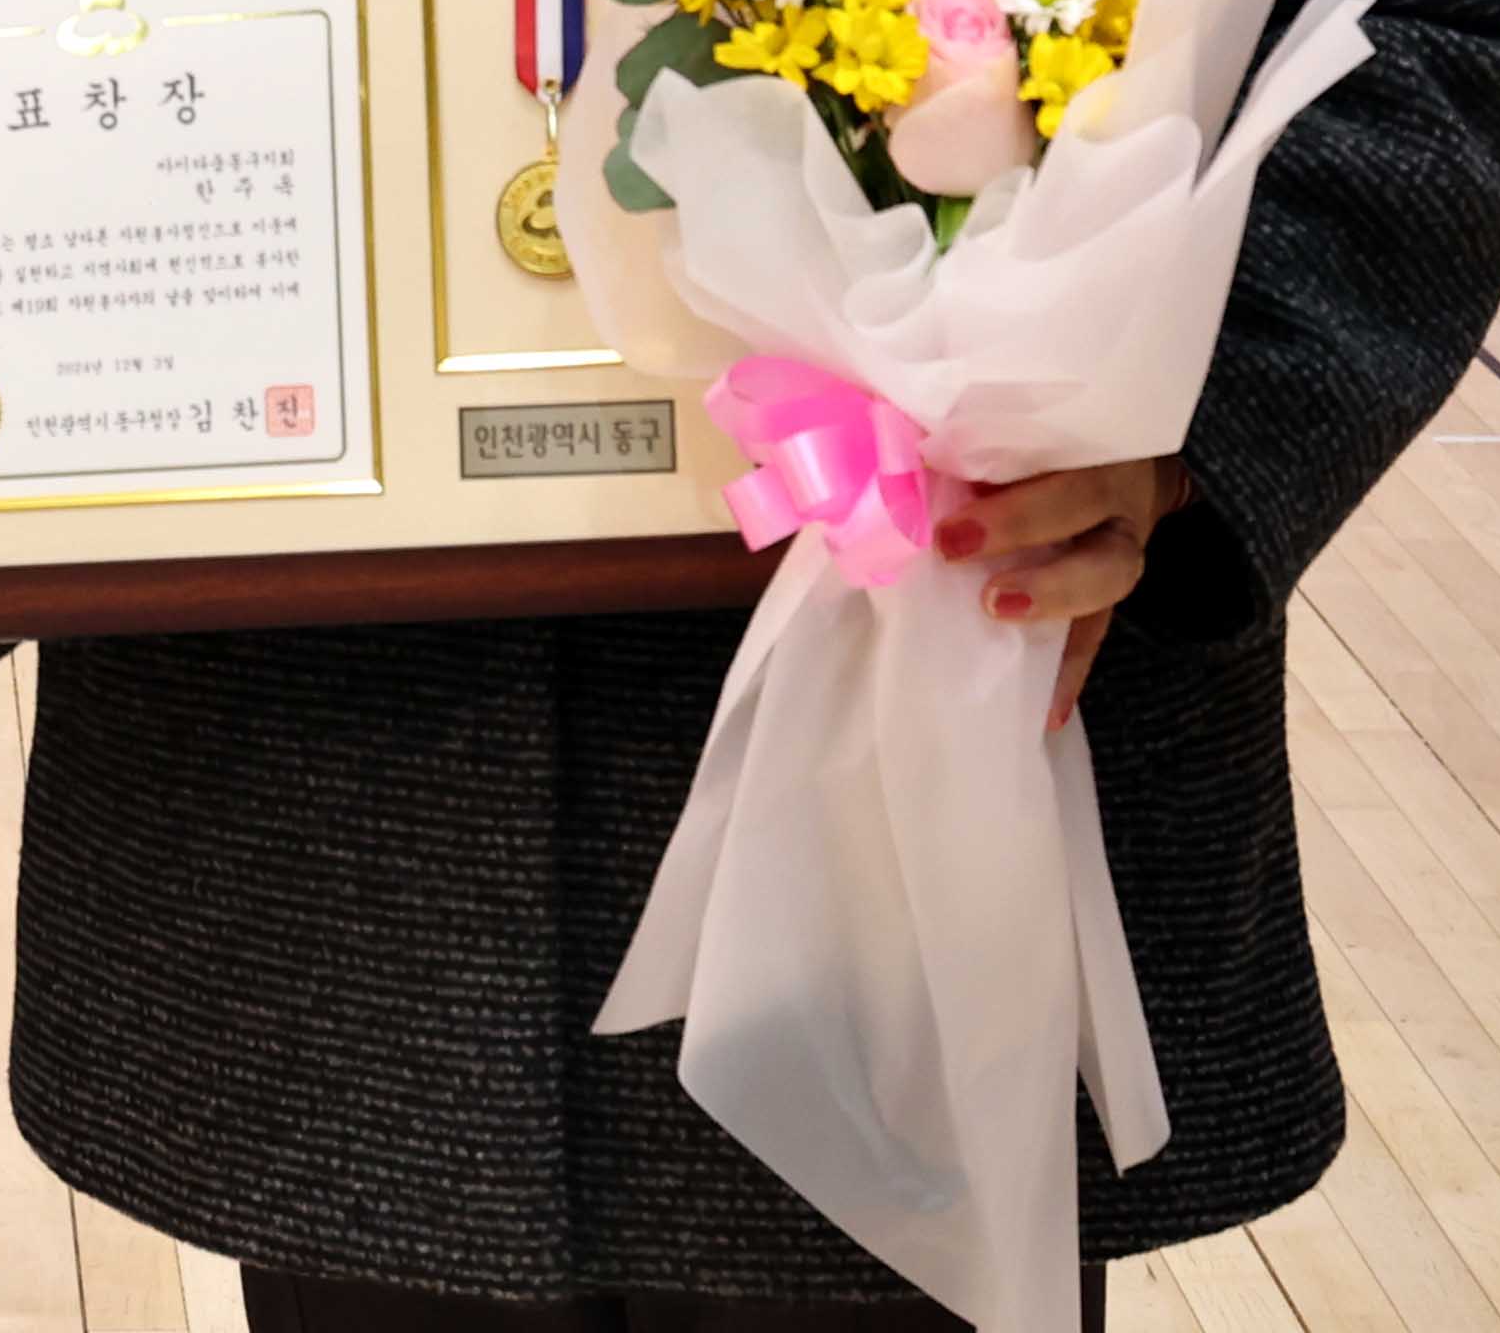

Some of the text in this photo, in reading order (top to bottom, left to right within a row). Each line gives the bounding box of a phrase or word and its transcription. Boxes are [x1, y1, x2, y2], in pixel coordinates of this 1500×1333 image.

[8, 72, 205, 131] 표창장
[474, 418, 661, 459] 인천광역시 동구
